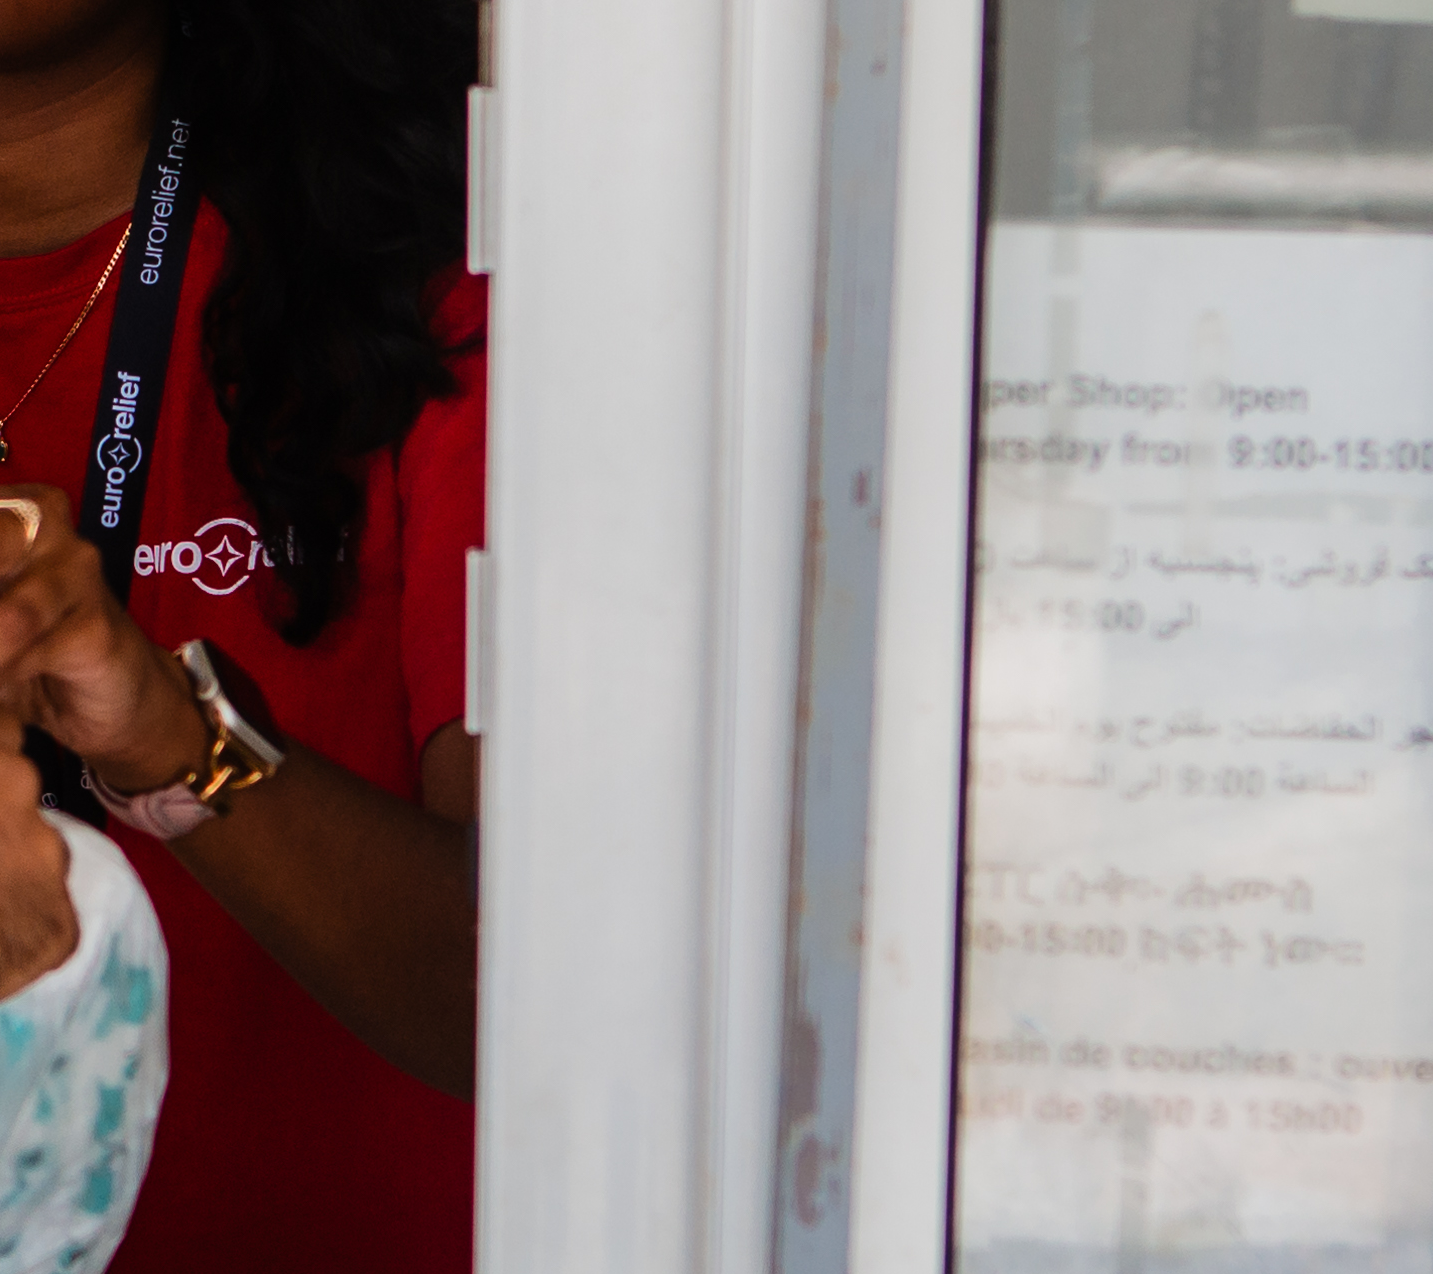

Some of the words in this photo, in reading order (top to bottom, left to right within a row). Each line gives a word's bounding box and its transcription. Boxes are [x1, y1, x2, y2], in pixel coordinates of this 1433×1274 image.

[139, 117, 191, 286] eurorelief.net
[113, 371, 143, 441] relief
[1066, 372, 1188, 417] Shop:
[101, 465, 128, 529] euro
[1123, 1045, 1295, 1079] couches
